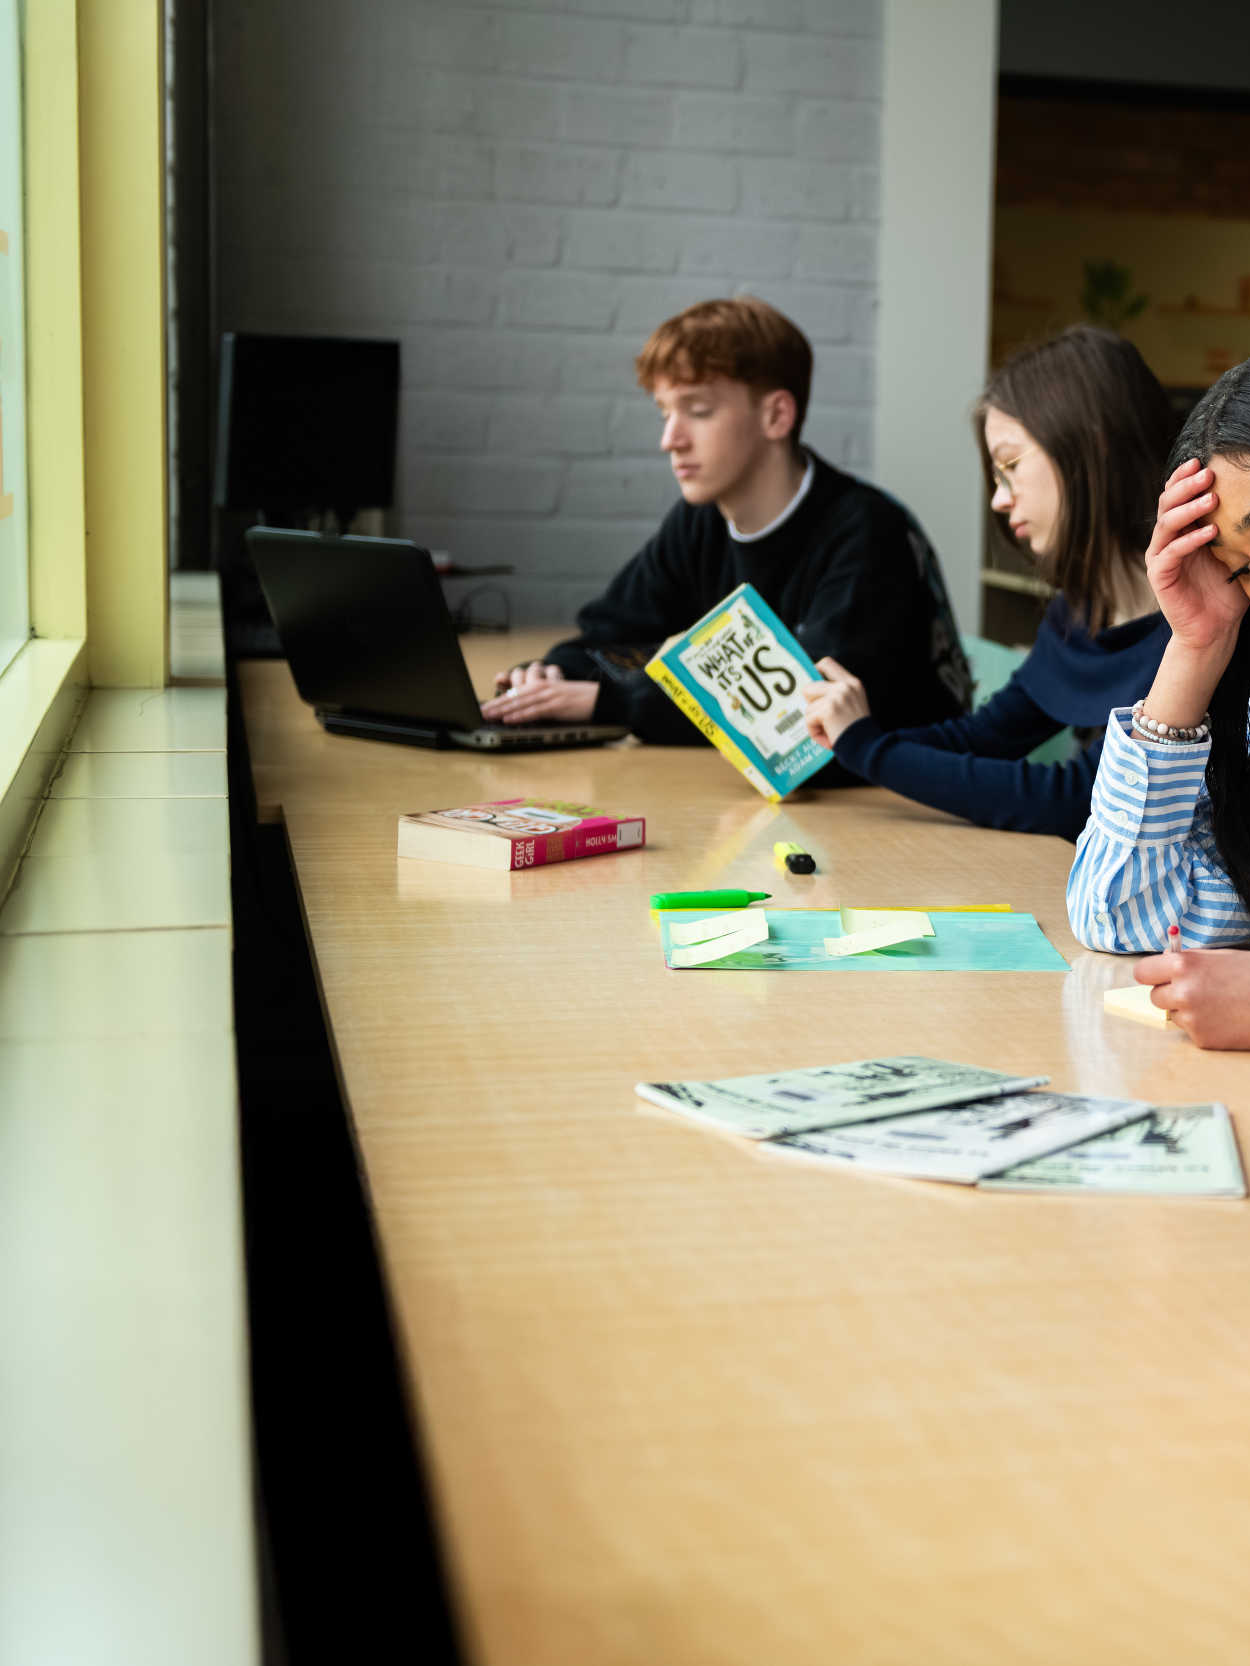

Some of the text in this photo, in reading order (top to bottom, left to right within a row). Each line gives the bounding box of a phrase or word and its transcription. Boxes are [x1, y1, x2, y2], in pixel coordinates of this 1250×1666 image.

[697, 632, 745, 679] WHAT
[737, 645, 796, 712] US
[585, 835, 606, 848] HOLLY
